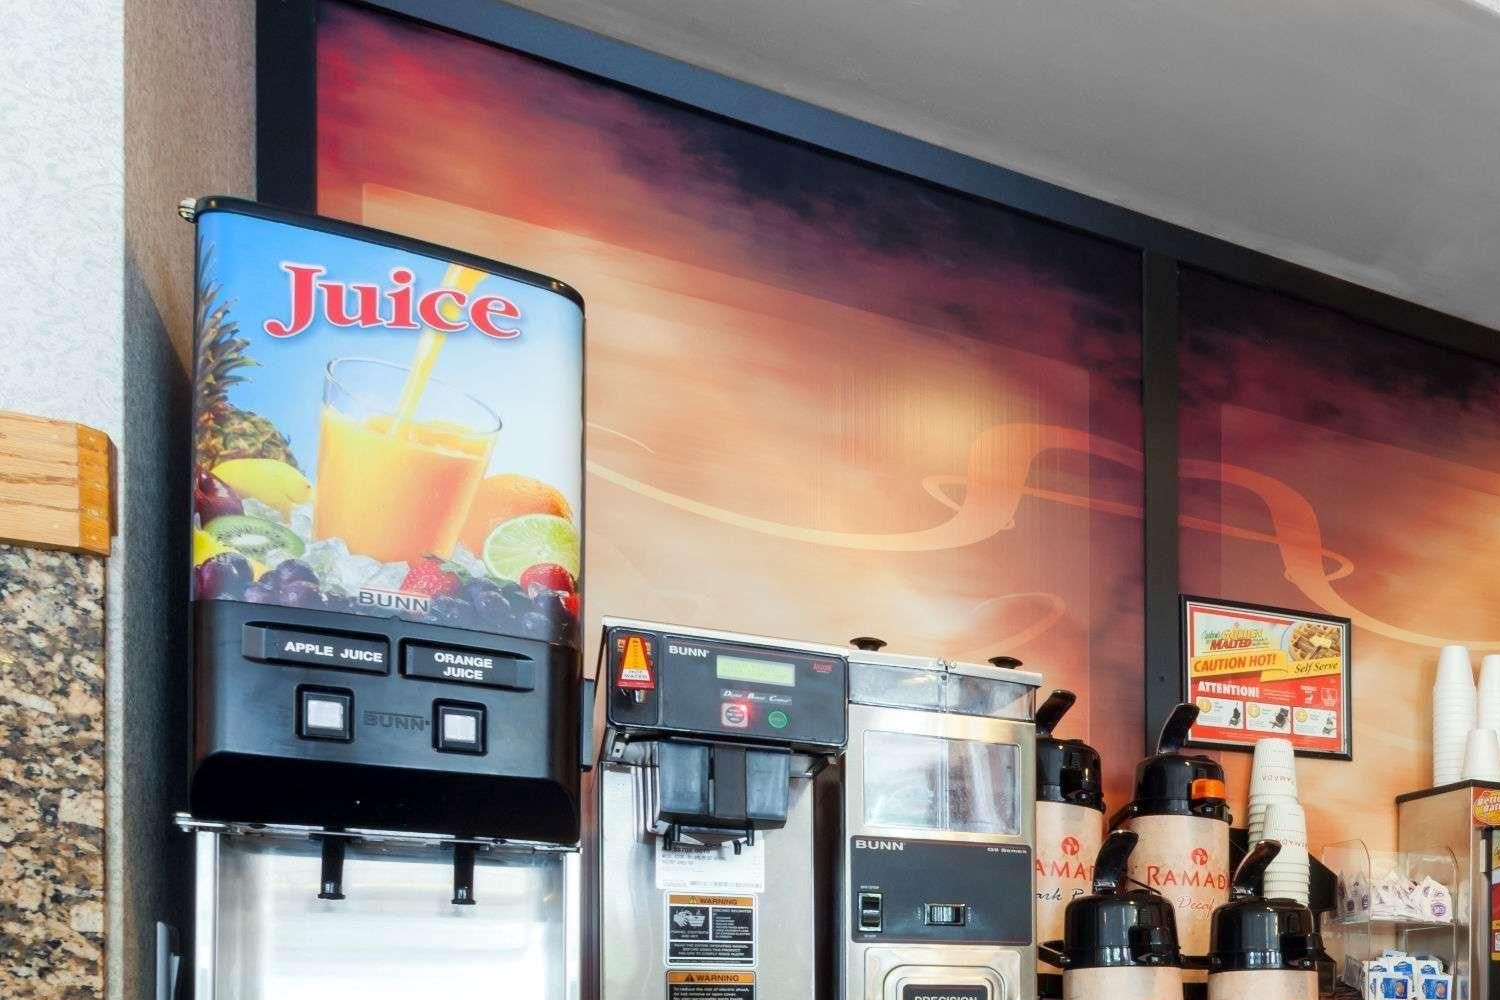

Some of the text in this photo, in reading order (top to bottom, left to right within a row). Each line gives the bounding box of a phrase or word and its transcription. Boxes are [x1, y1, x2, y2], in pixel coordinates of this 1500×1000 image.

[264, 261, 521, 339] Juice
[359, 591, 429, 612] BUNN
[284, 641, 383, 663] APPLE JUICE
[669, 645, 708, 658] BUNN
[1210, 639, 1253, 651] MALTED
[434, 652, 493, 669] ORANGE
[1193, 654, 1276, 673] CAUTION HOT!
[1294, 662, 1338, 674] Self Serve
[443, 667, 484, 680] JUICE
[1198, 681, 1260, 698] ATTENTION!
[855, 839, 904, 851] BUNN
[1034, 858, 1094, 881] AMA
[1147, 865, 1229, 890] RAMAD
[700, 897, 738, 906] WARNING
[1035, 887, 1062, 901] ark
[696, 974, 739, 982] WARNING
